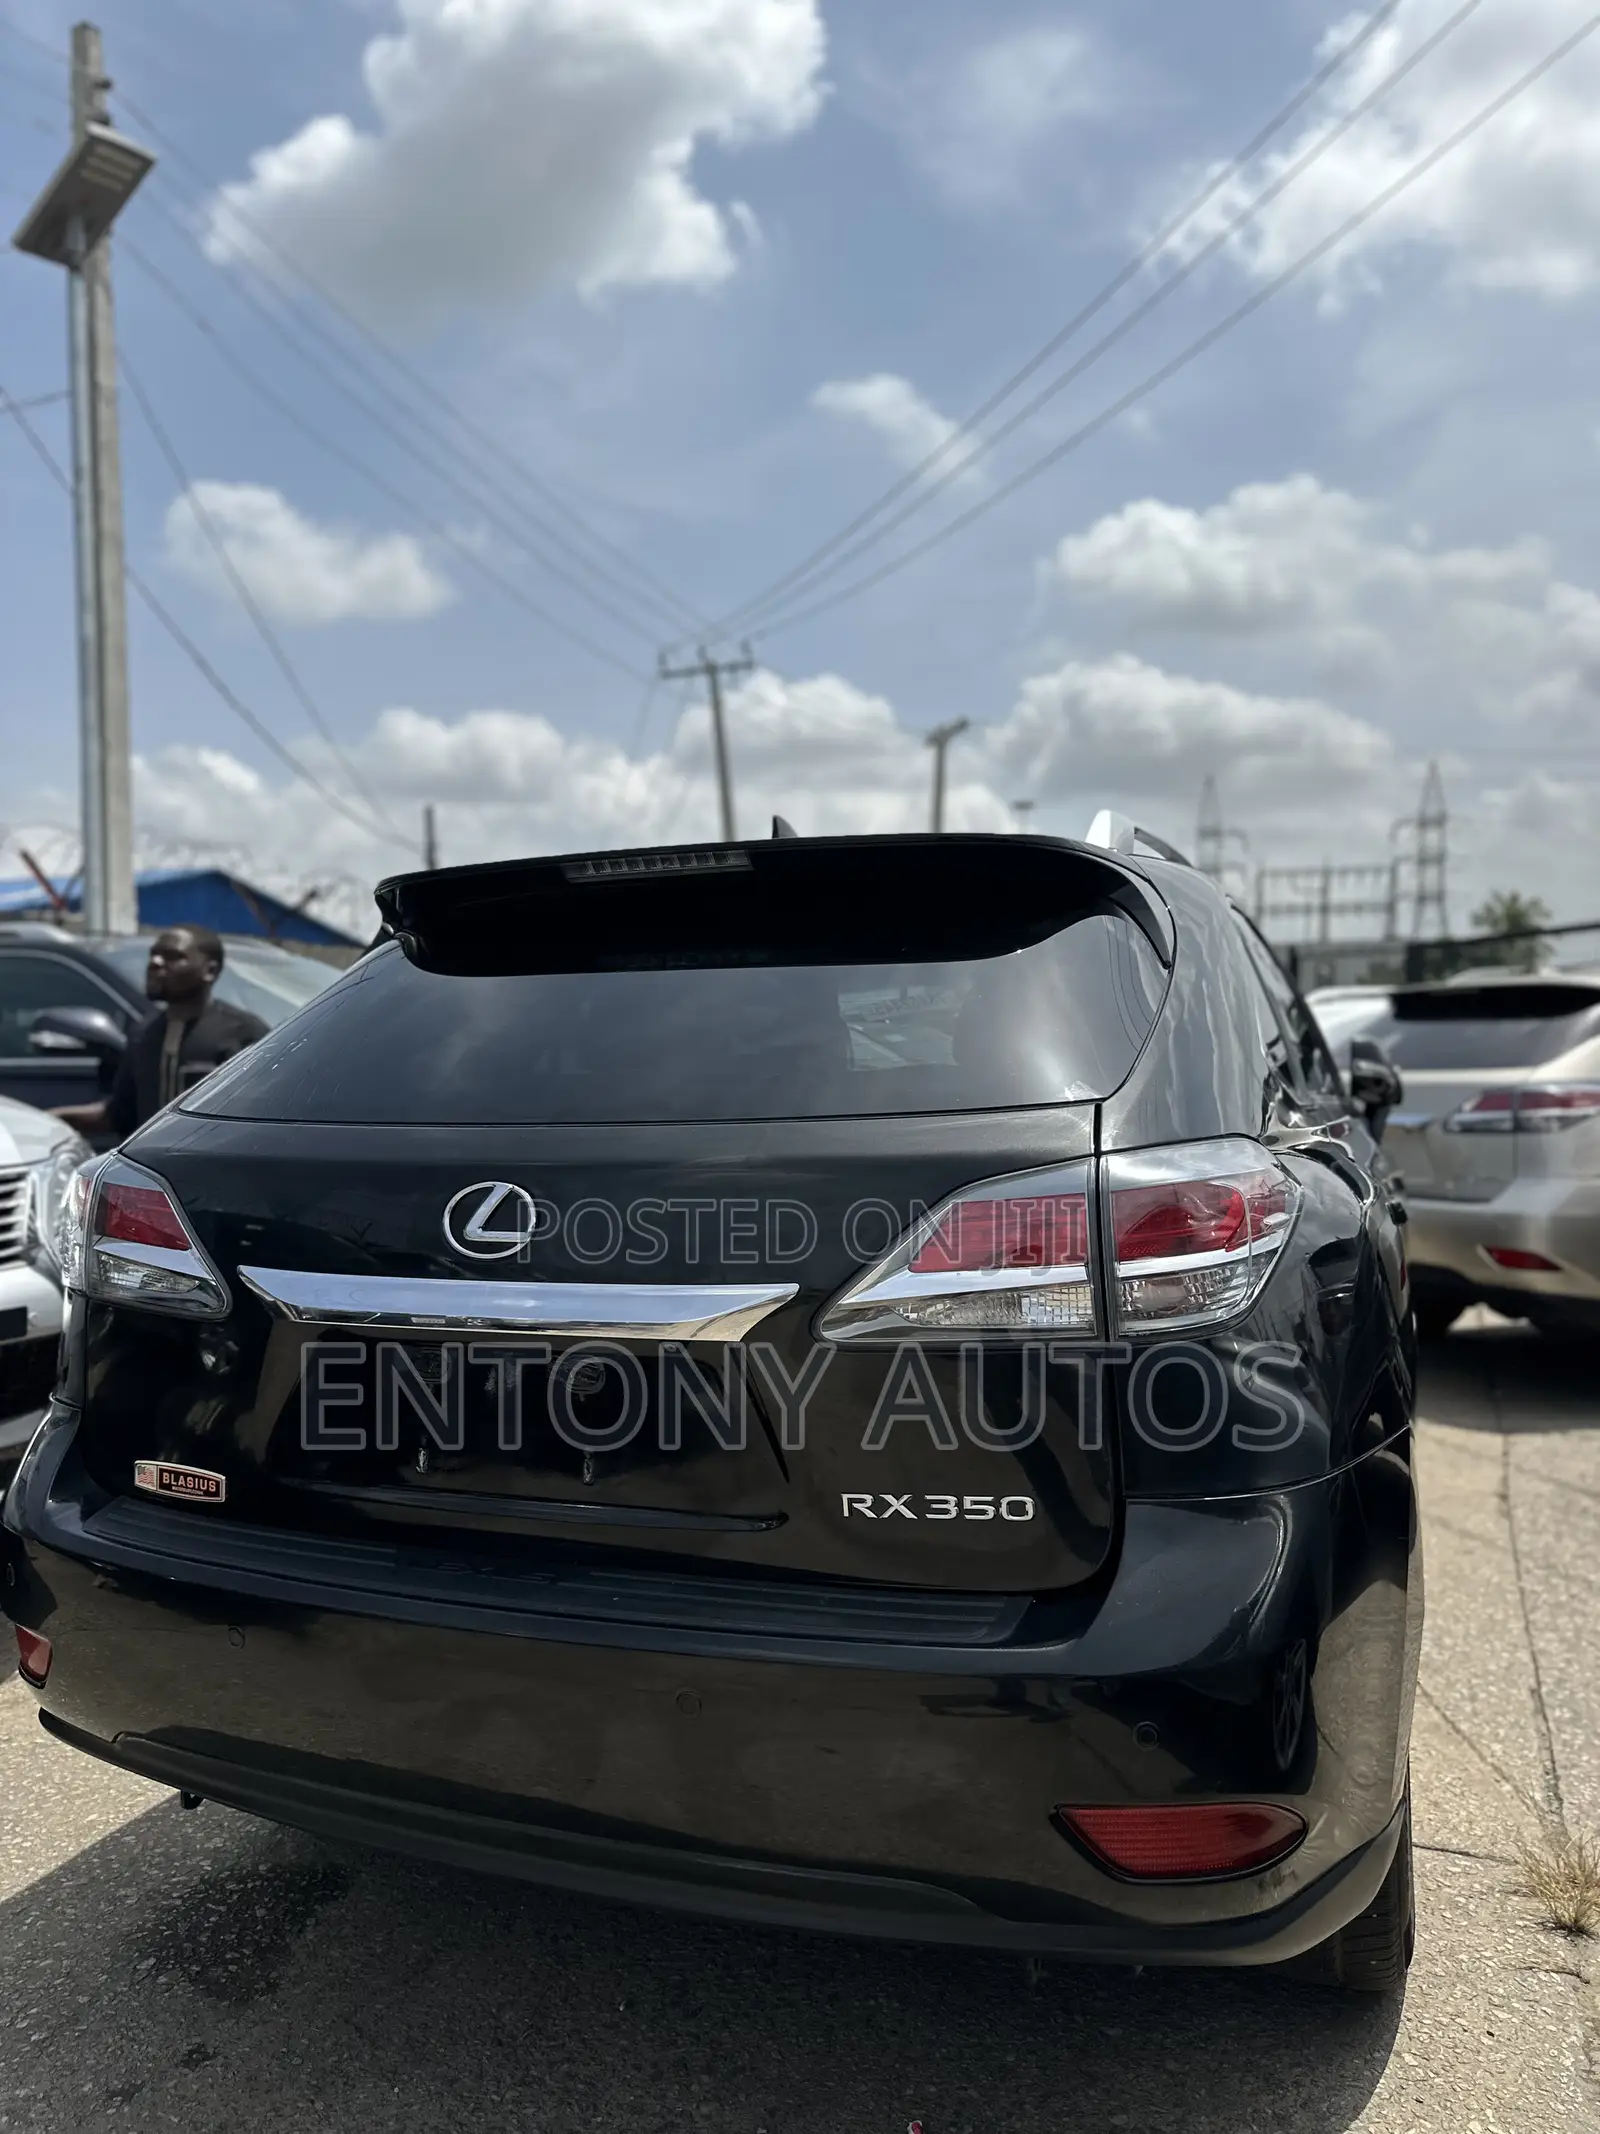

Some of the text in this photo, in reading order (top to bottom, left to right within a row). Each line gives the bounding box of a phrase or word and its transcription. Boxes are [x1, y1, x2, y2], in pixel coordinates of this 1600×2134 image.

[162, 1472, 216, 1492] BLASIUS
[841, 1493, 1035, 1521] RX 350
